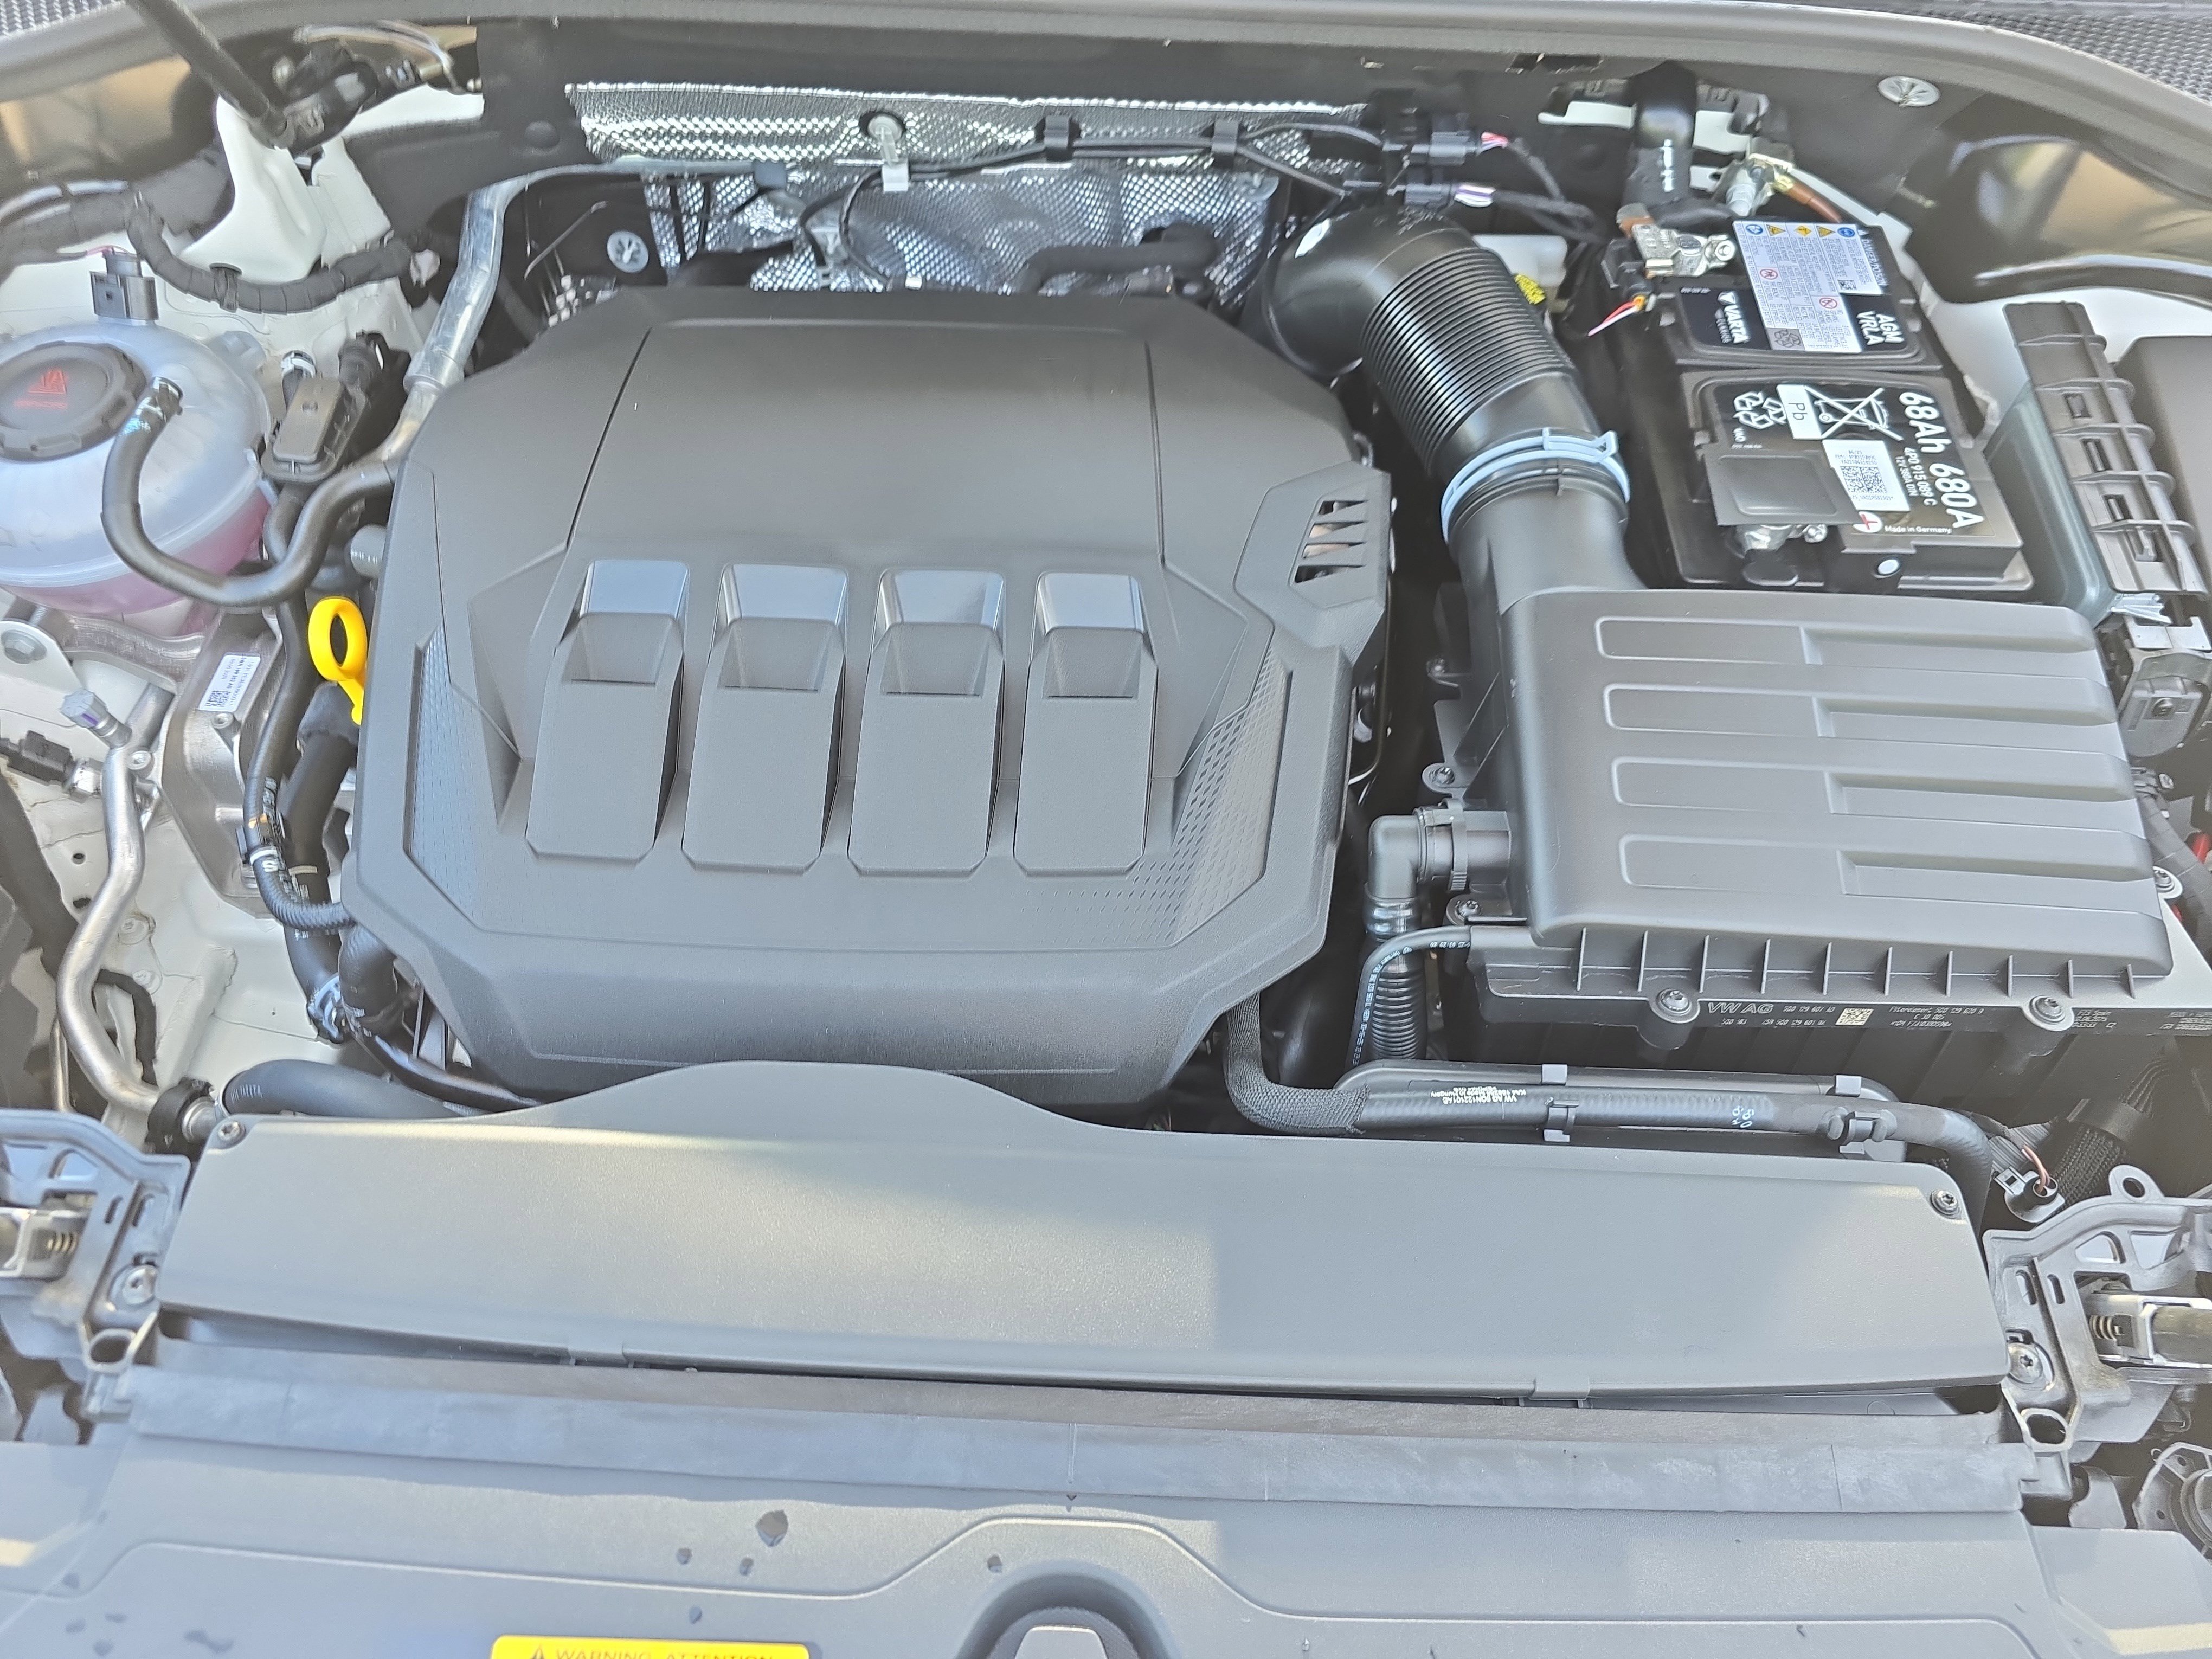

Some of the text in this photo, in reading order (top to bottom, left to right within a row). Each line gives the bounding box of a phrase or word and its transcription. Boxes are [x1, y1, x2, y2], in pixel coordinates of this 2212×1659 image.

[1724, 304, 1751, 344] VARTA
[1856, 311, 1886, 345] VRLA
[1875, 314, 1904, 343] AGM
[1793, 403, 1807, 421] Pb
[1899, 391, 1984, 528] 68Ah 680A
[1903, 447, 1919, 464] 4P0
[1895, 456, 1919, 497] 12V 380A DIN
[1910, 464, 1926, 480] 915
[1914, 480, 1931, 498] 089
[1916, 526, 1952, 535] Germany
[1708, 1002, 1774, 1014] VW AG
